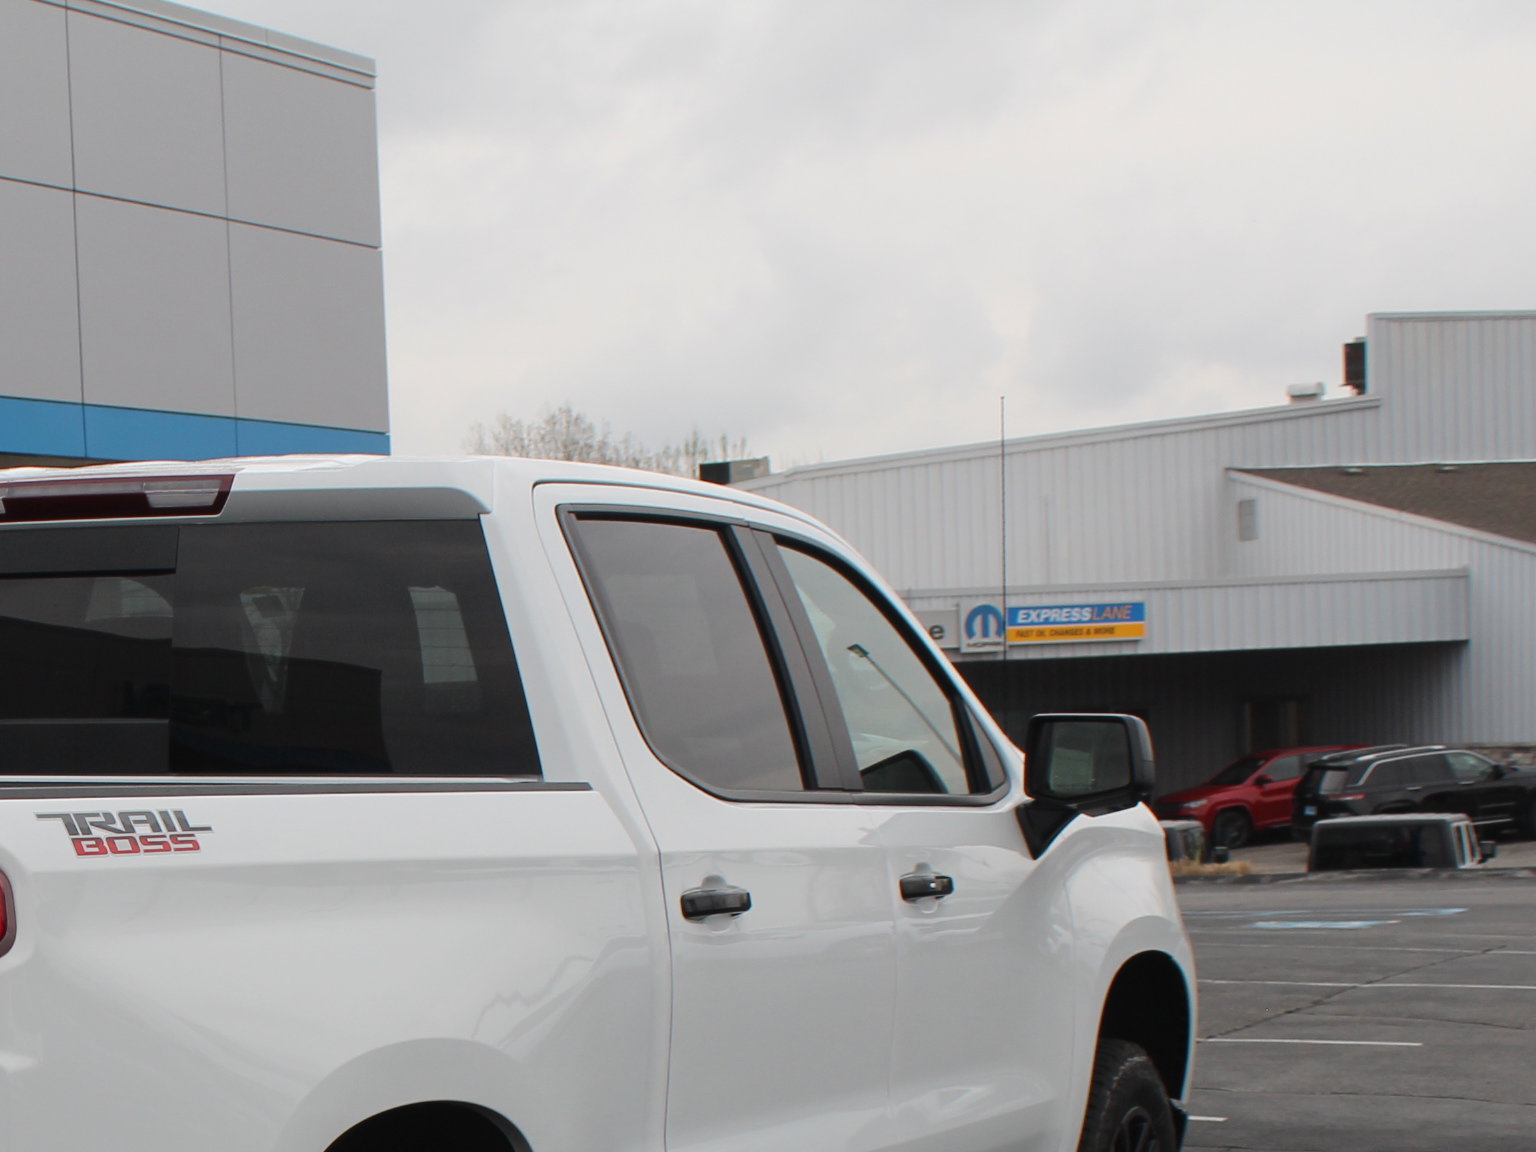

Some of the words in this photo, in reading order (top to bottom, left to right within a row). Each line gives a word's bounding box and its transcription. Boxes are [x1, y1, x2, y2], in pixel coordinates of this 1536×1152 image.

[1017, 605, 1133, 623] EXPRESSLANE
[35, 810, 212, 835] TRAIL
[71, 833, 200, 856] BOSS
